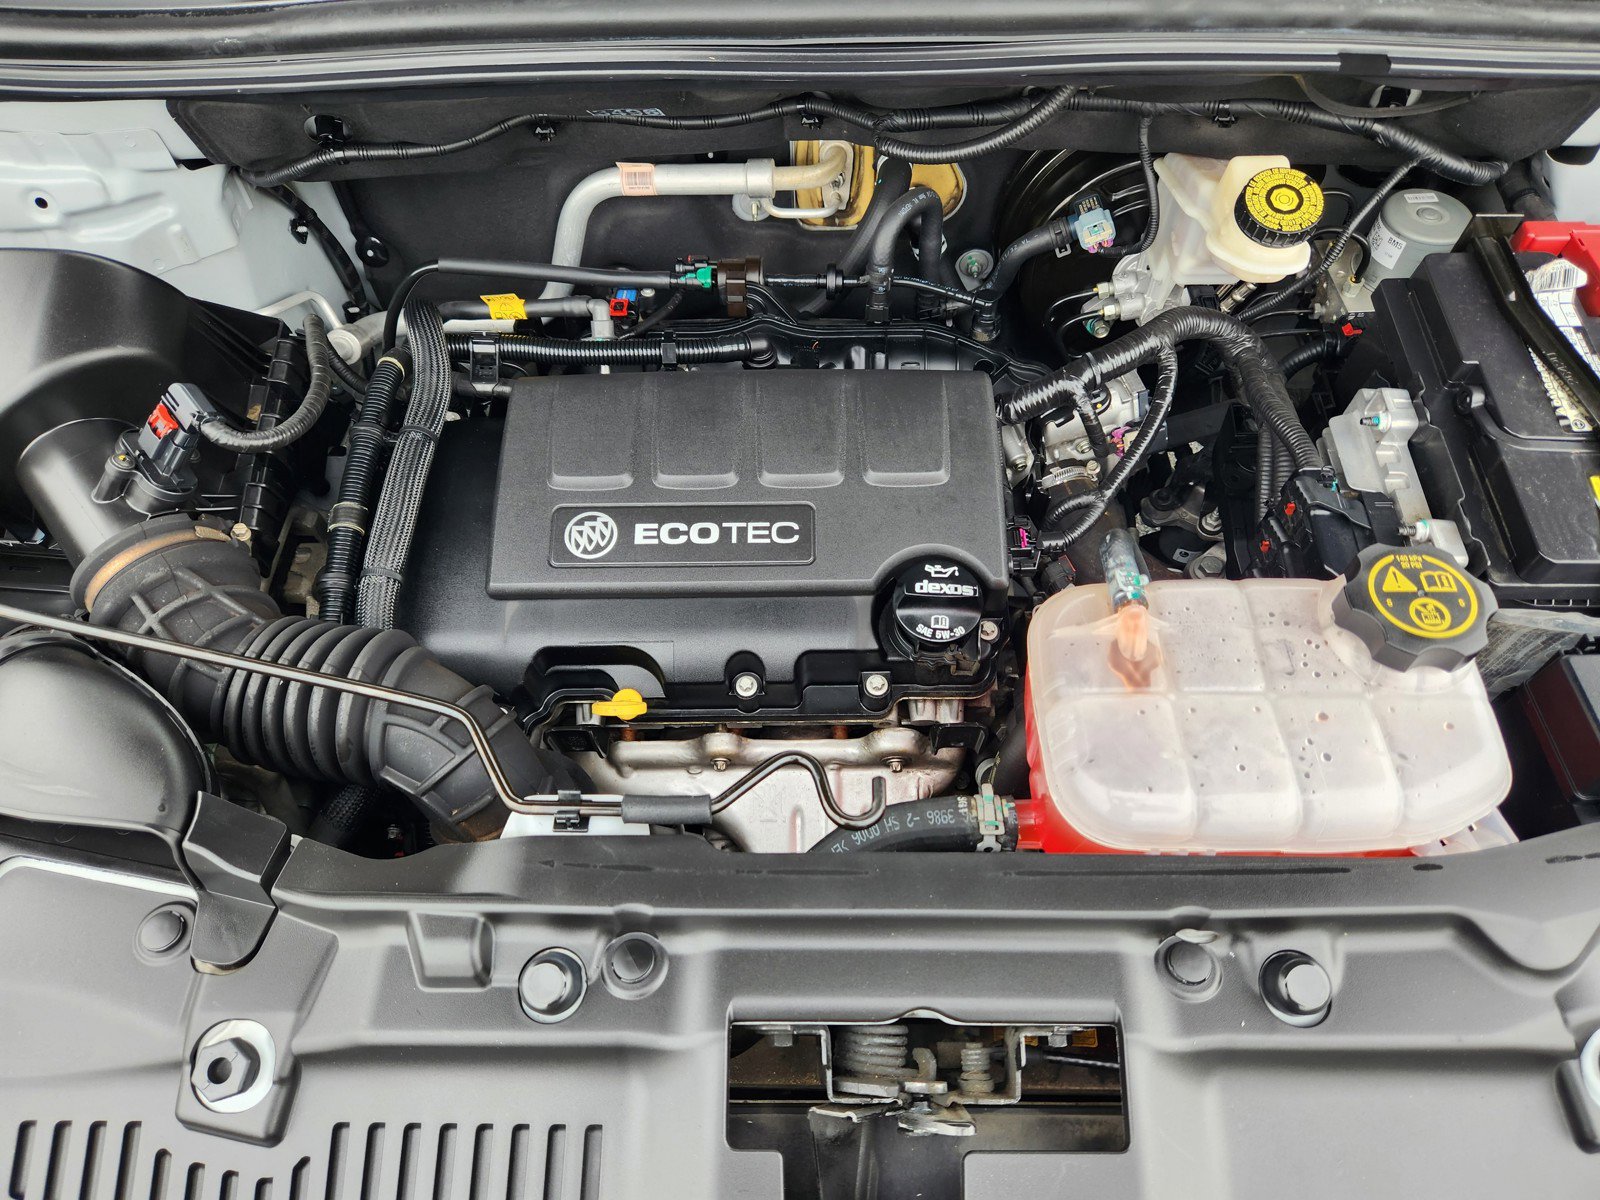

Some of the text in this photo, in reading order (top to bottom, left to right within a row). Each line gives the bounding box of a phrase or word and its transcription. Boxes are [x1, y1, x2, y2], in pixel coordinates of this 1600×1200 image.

[634, 521, 800, 545] ECOTEC
[916, 623, 966, 640] SAE 5W-30
[926, 809, 955, 825] 3986
